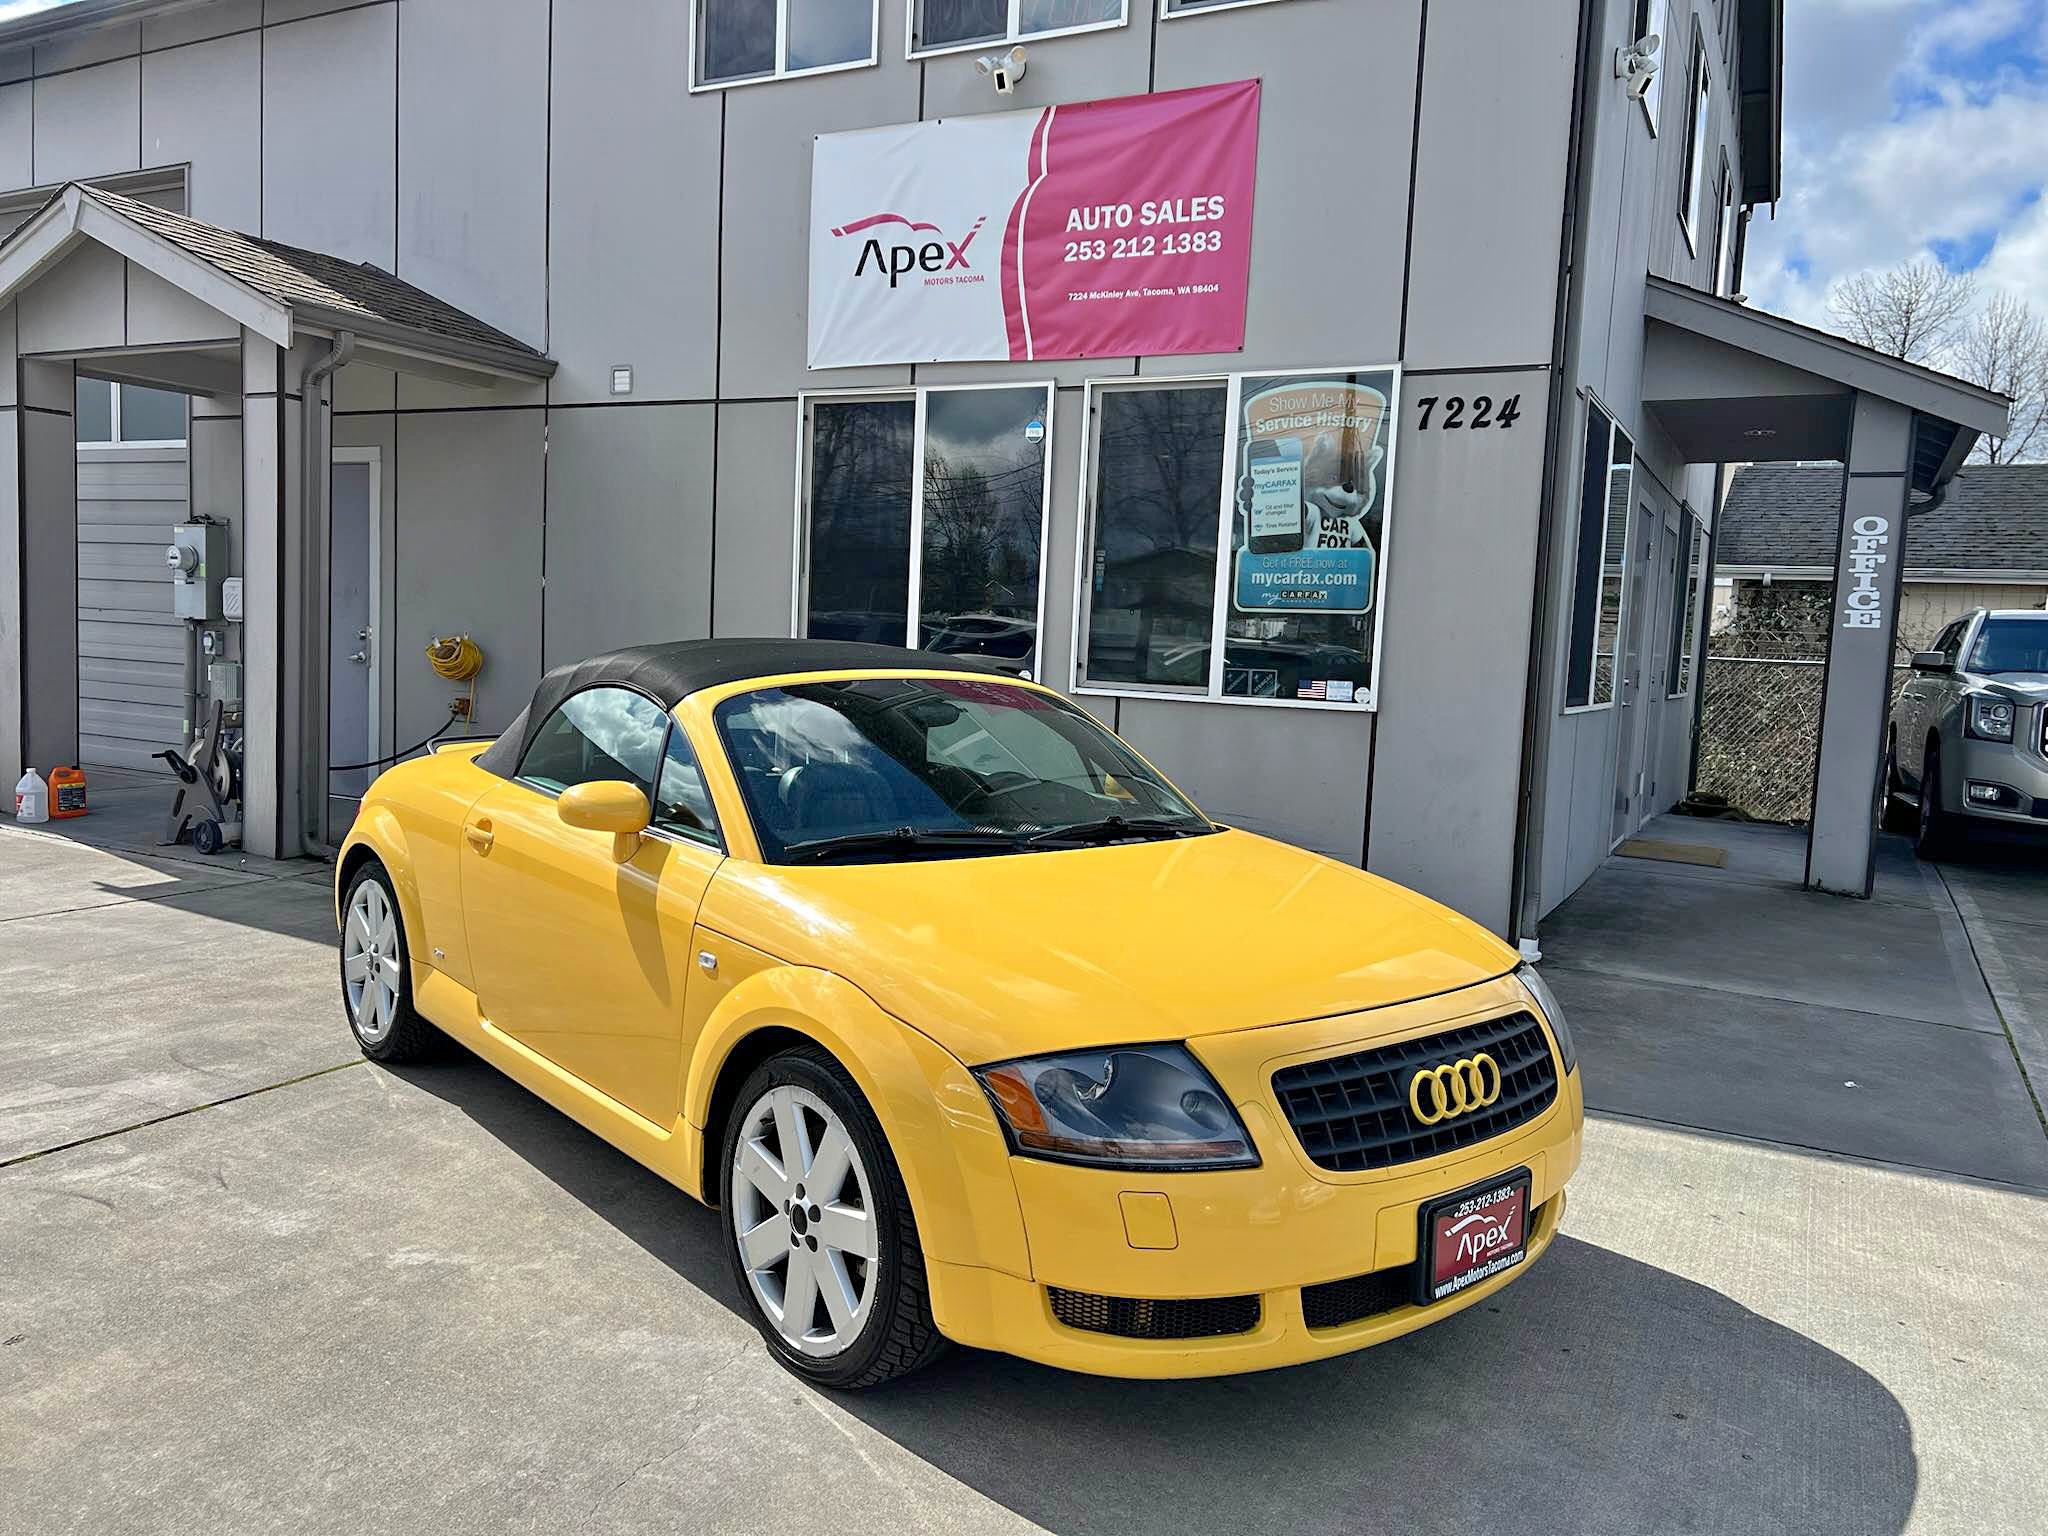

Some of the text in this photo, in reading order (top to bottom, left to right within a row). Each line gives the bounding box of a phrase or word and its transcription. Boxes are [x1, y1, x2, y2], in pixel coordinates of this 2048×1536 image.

[1065, 195, 1225, 232] AUTO SALES
[854, 225, 981, 288] Apex
[1064, 230, 1222, 262] 253 212 1383
[924, 275, 985, 286] MOTORS TACOMA
[1068, 283, 1219, 301] 7224 McKinley Ave, Tacoma, WA 98404
[1269, 396, 1307, 413] Show
[1311, 392, 1334, 407] Me
[1417, 394, 1521, 431] 7224
[1255, 411, 1372, 433] Service History
[1320, 518, 1349, 535] CAR
[1317, 533, 1349, 548] FOX
[1262, 557, 1279, 569] Get
[1289, 558, 1314, 568] FREE
[1315, 559, 1335, 568] now
[1339, 558, 1348, 568] at
[1842, 516, 1889, 629] OFFICE
[1251, 570, 1358, 588] mycarfax.com
[1456, 1211, 1514, 1264] Apex
